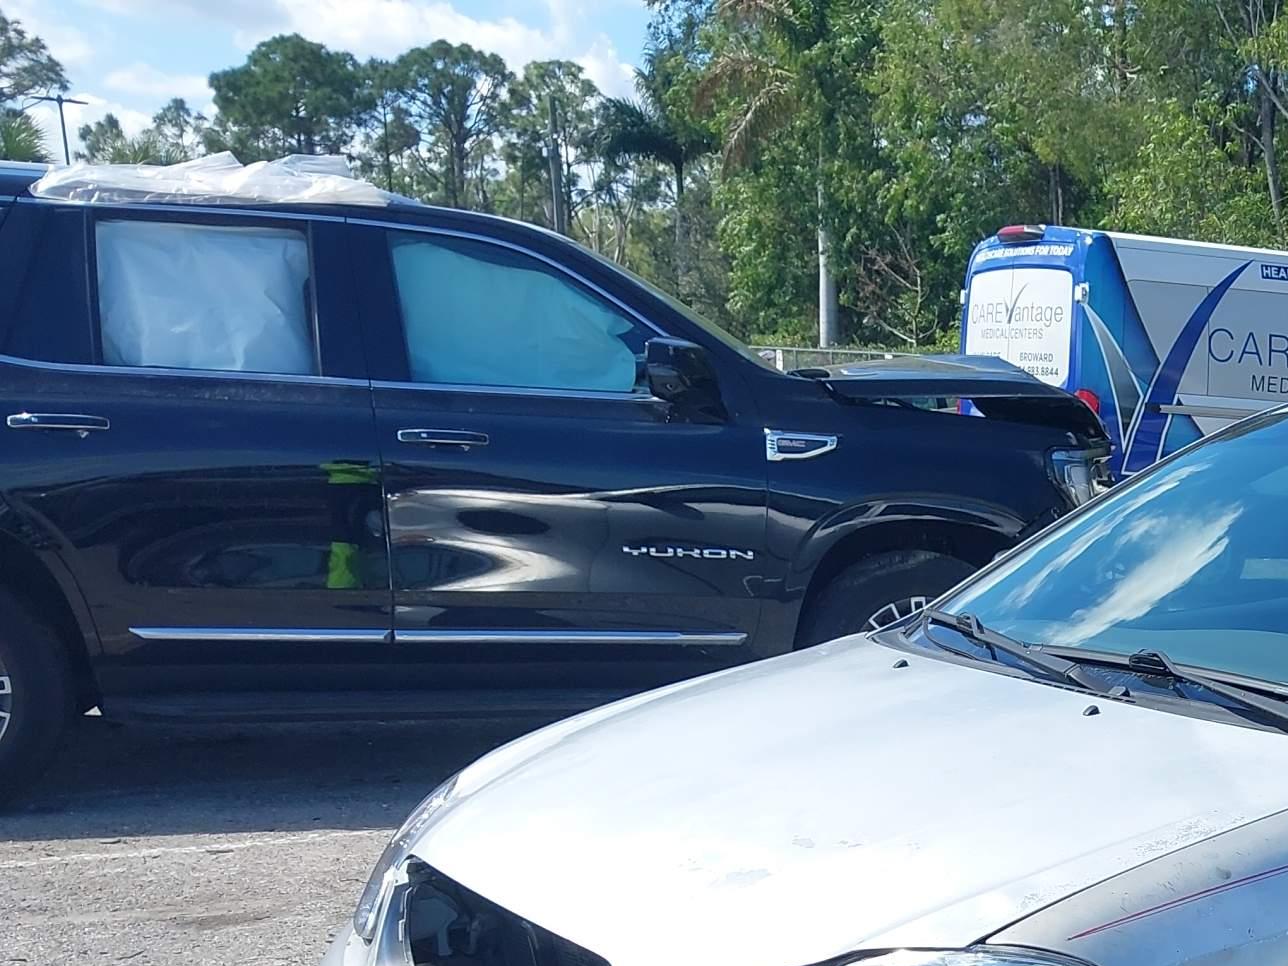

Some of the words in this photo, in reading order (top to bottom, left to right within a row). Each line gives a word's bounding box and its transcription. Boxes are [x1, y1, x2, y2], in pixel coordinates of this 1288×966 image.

[1050, 245, 1073, 256] TODAY
[981, 328, 1008, 339] MEDICAL
[1010, 328, 1044, 339] CENTERS
[1020, 352, 1054, 362] BROWARD
[778, 439, 806, 447] GMC
[622, 546, 754, 560] YUKON
